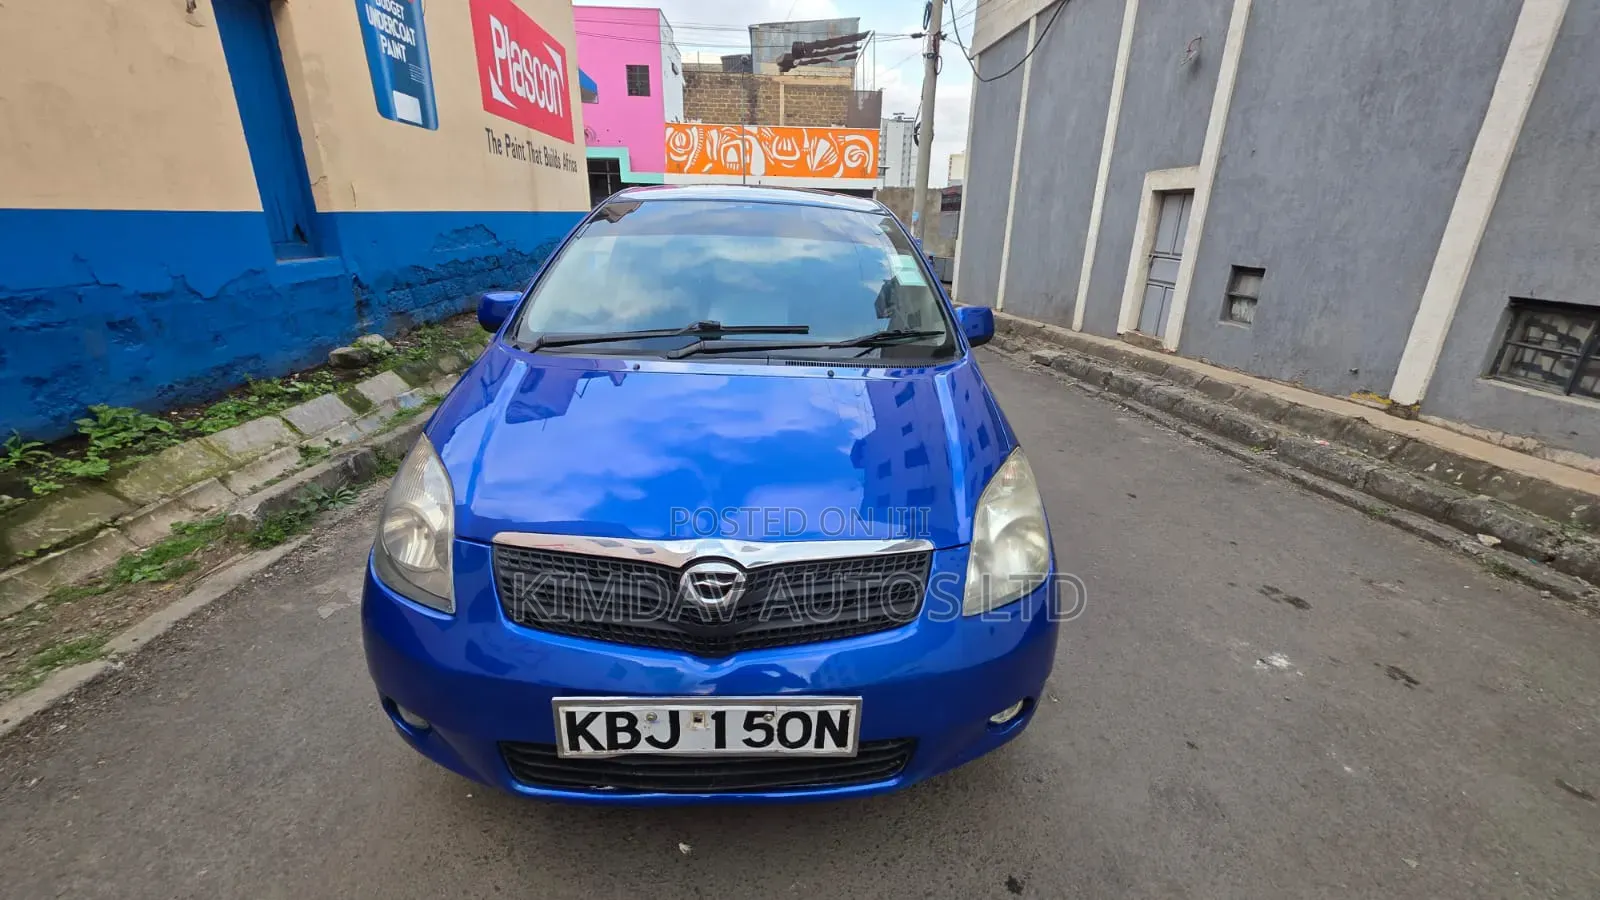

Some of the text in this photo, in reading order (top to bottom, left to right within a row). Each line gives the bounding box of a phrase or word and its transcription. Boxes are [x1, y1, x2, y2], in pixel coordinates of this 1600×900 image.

[365, 3, 416, 46] UNDERCOAT
[380, 34, 407, 63] PAINT
[489, 14, 563, 118] Plascon
[485, 128, 578, 173] The Paint That Builds Africa
[565, 709, 850, 751] KBJ 150N
